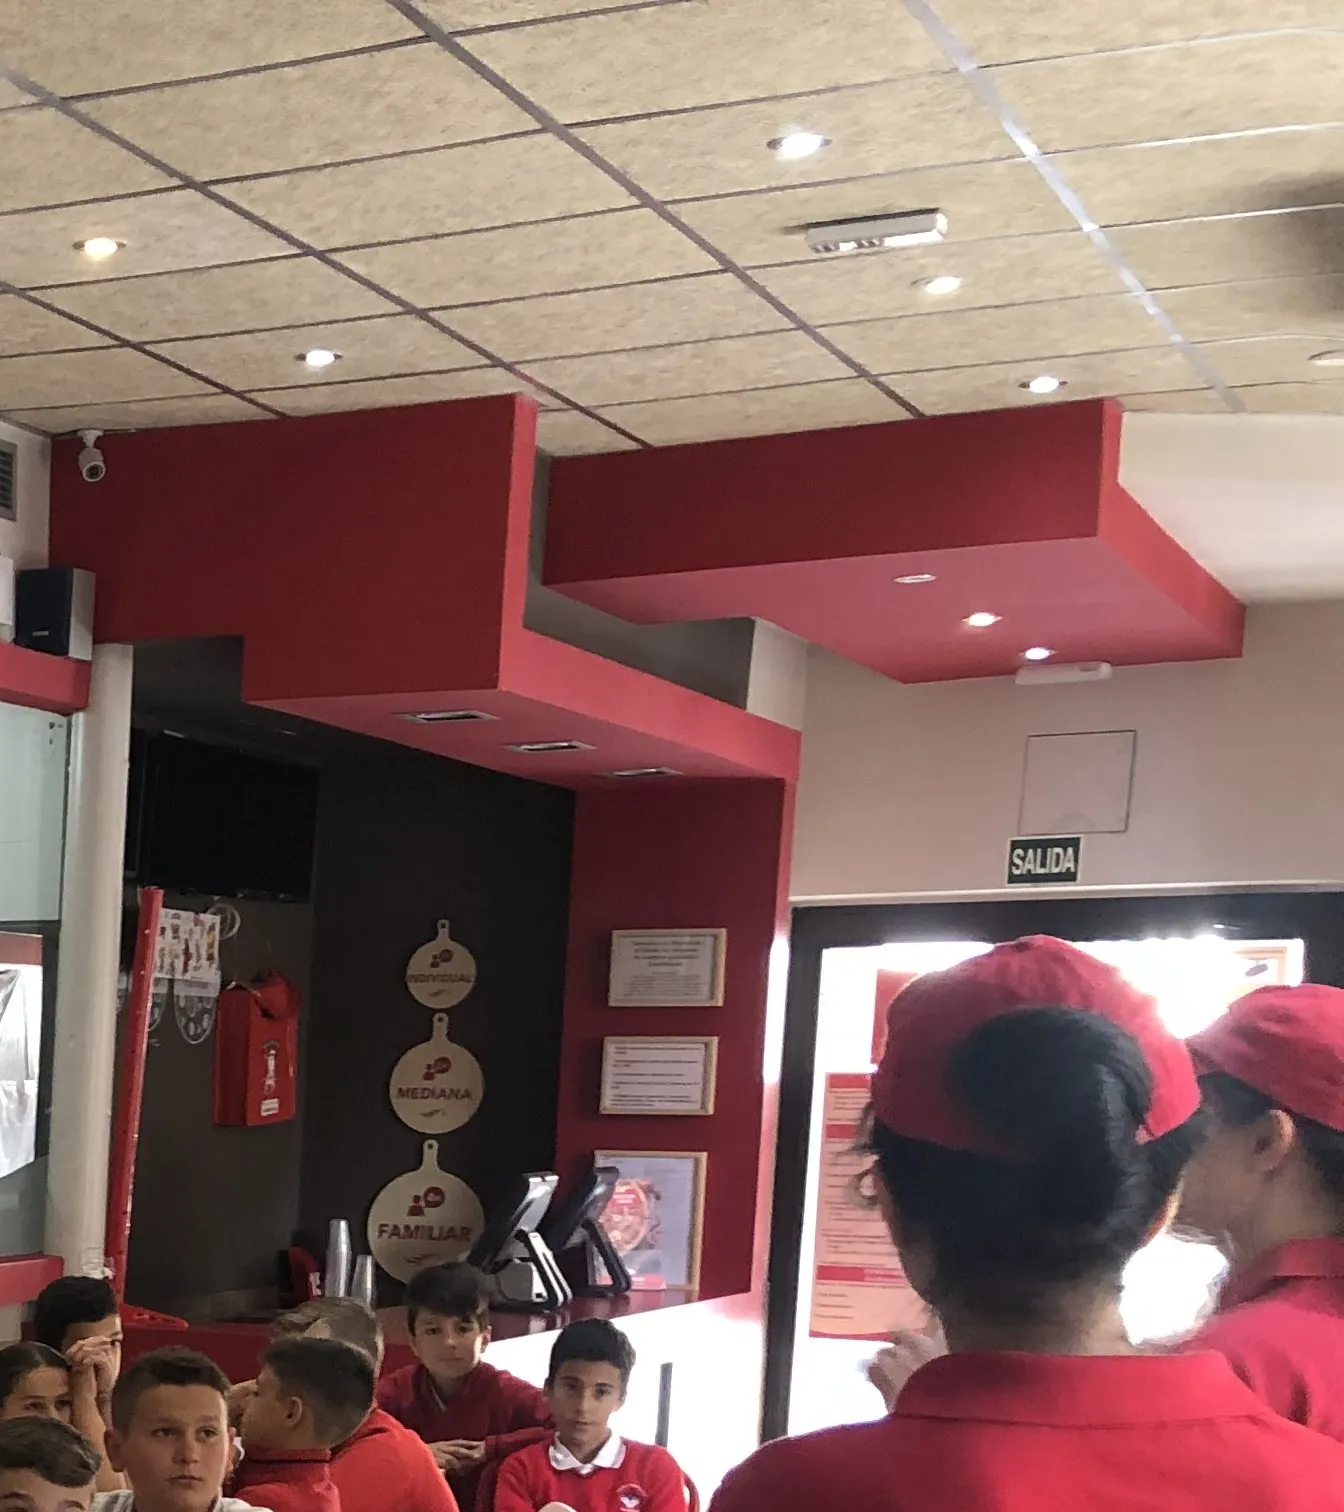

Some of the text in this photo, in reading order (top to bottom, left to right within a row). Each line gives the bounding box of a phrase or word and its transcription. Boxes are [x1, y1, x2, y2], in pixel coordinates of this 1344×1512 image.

[1011, 846, 1076, 875] SALIDA
[406, 973, 472, 983] INDIVIDUAL
[396, 1087, 472, 1100] MEDIANA
[377, 1223, 473, 1241] FAMILIAR
